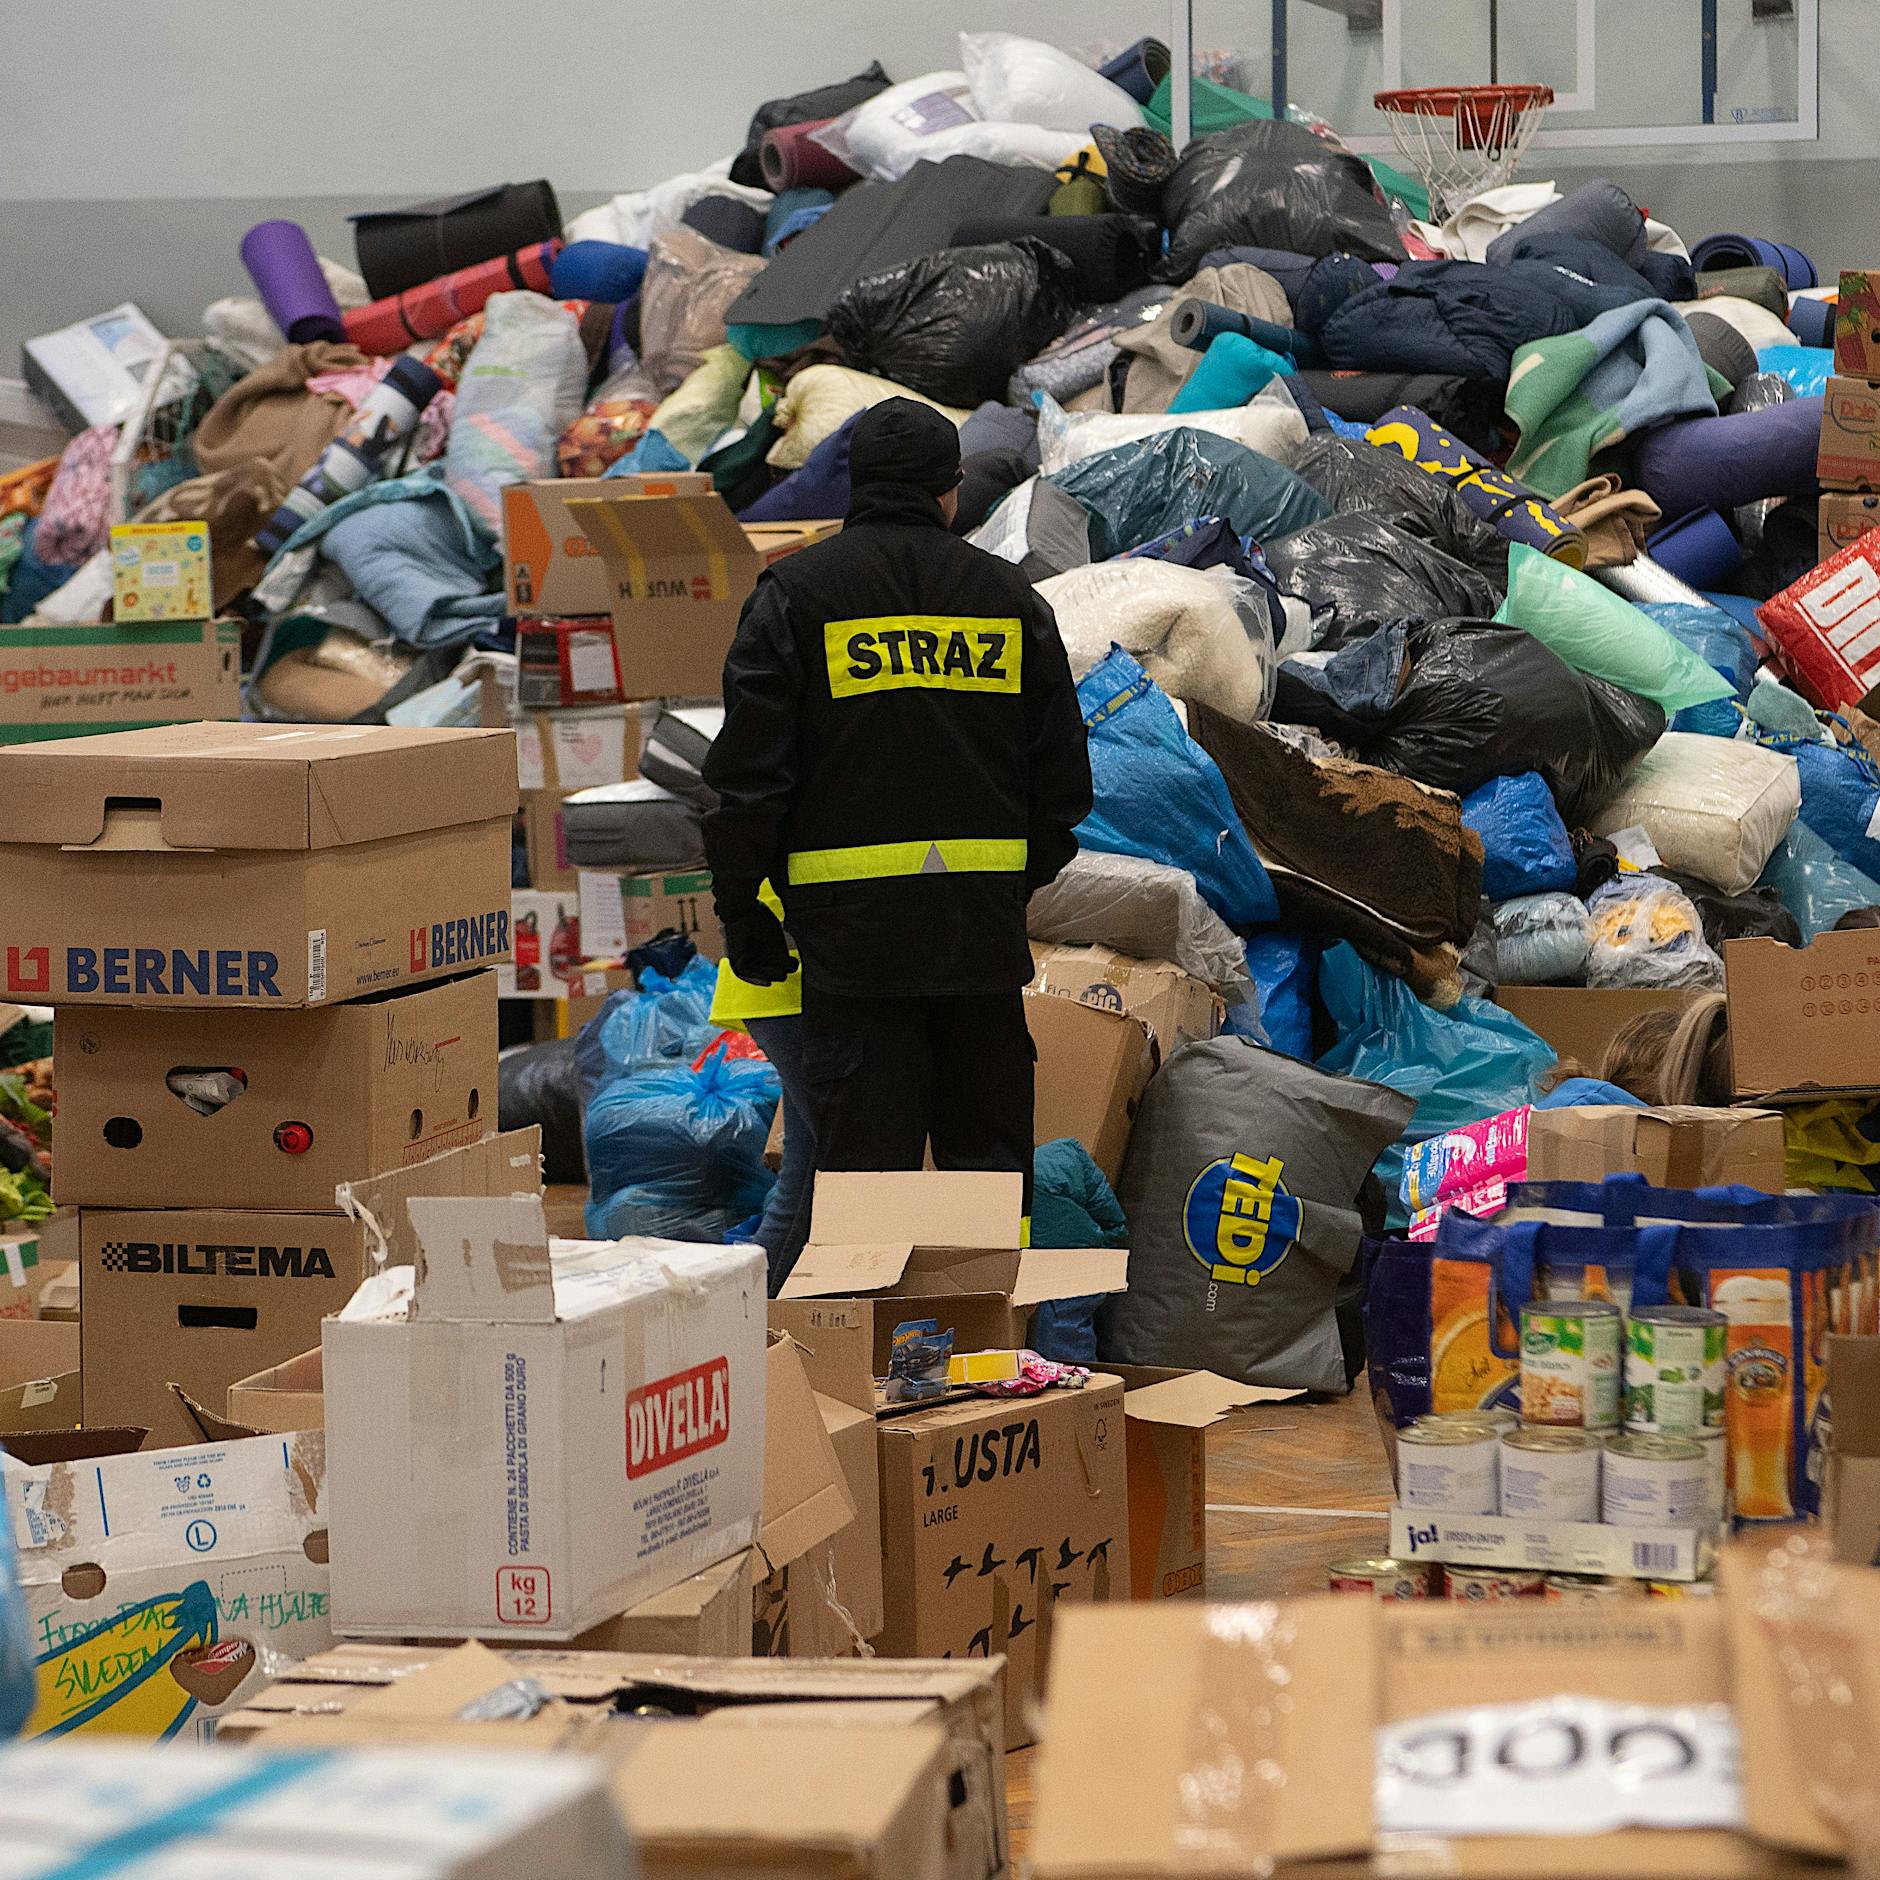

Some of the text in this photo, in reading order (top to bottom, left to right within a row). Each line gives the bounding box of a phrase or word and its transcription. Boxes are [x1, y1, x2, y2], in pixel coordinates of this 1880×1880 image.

[0, 662, 176, 693] gebaumarkt
[431, 910, 510, 968] BERNER
[66, 947, 283, 996] BERNER
[126, 1242, 336, 1279] BILTEMA
[1206, 1281, 1219, 1312] .com
[505, 1385, 515, 1401] DA
[505, 1403, 516, 1466] PACCHETTI
[629, 1369, 727, 1467] DIVELLA
[516, 1358, 530, 1552] PASTA DI SEMOLA DI GRANO DURO
[922, 1418, 1041, 1498] USTA
[508, 1499, 518, 1555] CONTIENE
[923, 1505, 958, 1528] LARGE
[195, 1526, 209, 1545] L
[1407, 1524, 1439, 1553] ja!
[512, 1573, 536, 1595] kg
[513, 1599, 536, 1616] 12
